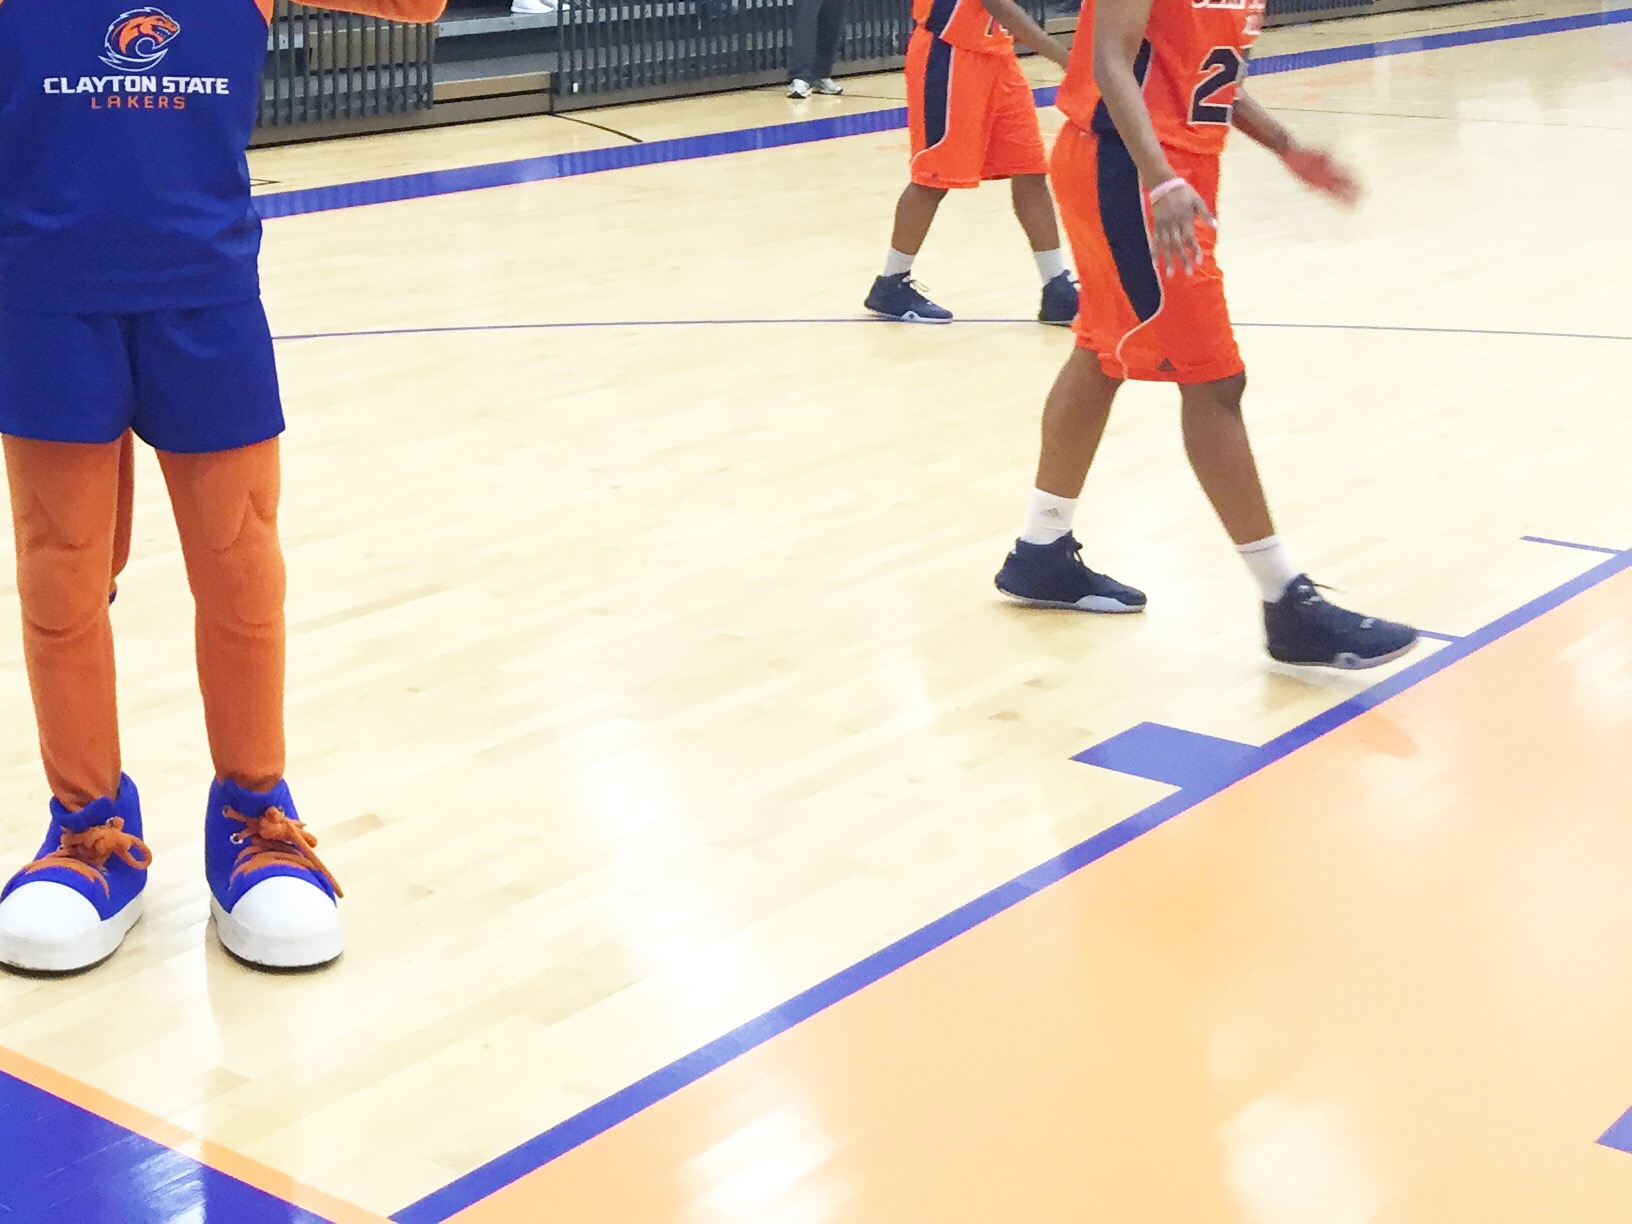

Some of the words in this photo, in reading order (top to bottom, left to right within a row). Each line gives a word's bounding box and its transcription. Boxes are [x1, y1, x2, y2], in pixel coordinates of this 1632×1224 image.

[43, 75, 156, 94] CLAYTON
[162, 77, 229, 94] STATE
[91, 95, 186, 110] LAKERS
